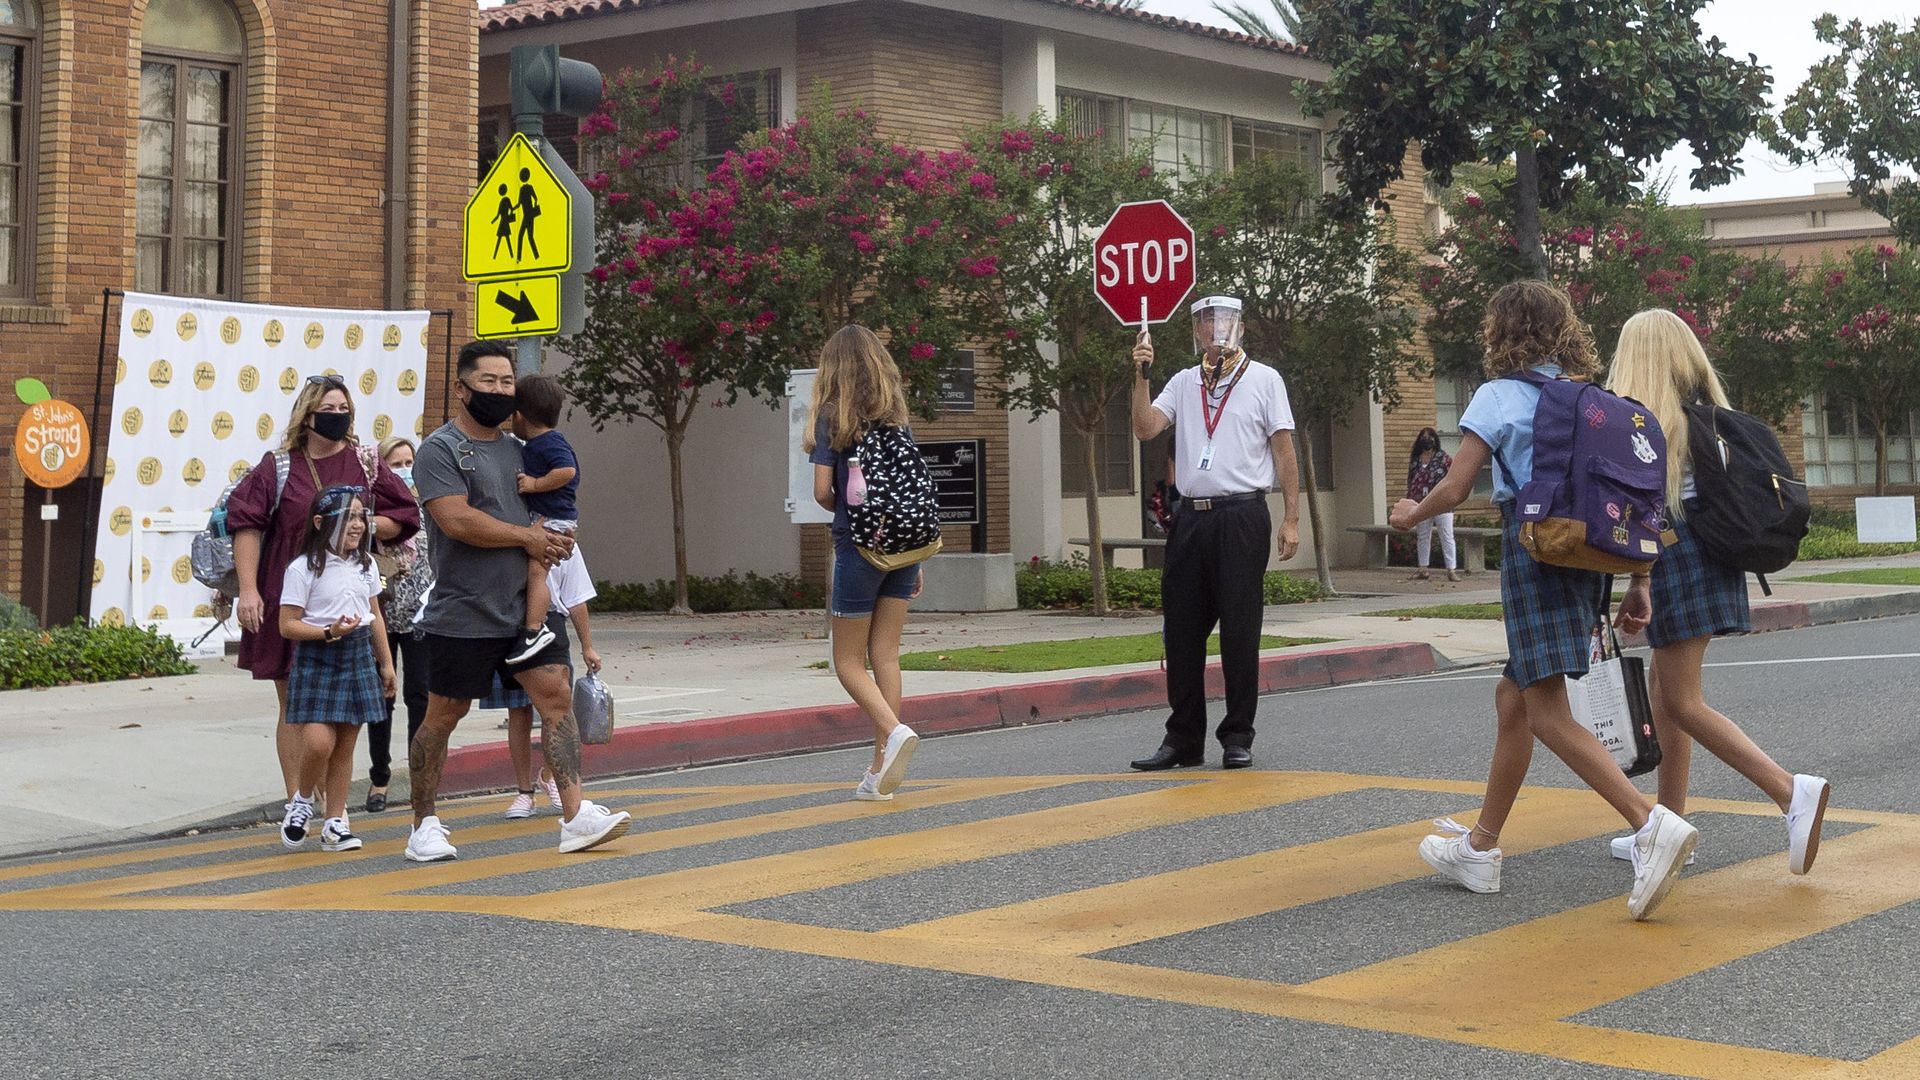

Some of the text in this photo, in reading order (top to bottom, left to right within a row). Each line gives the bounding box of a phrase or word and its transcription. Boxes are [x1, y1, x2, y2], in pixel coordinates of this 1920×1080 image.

[1100, 238, 1188, 288] STOP
[47, 406, 74, 424] John's
[24, 422, 81, 459] Strong
[1593, 719, 1614, 730] THIS
[1596, 731, 1604, 739] IS
[1602, 737, 1623, 747] OGA.
